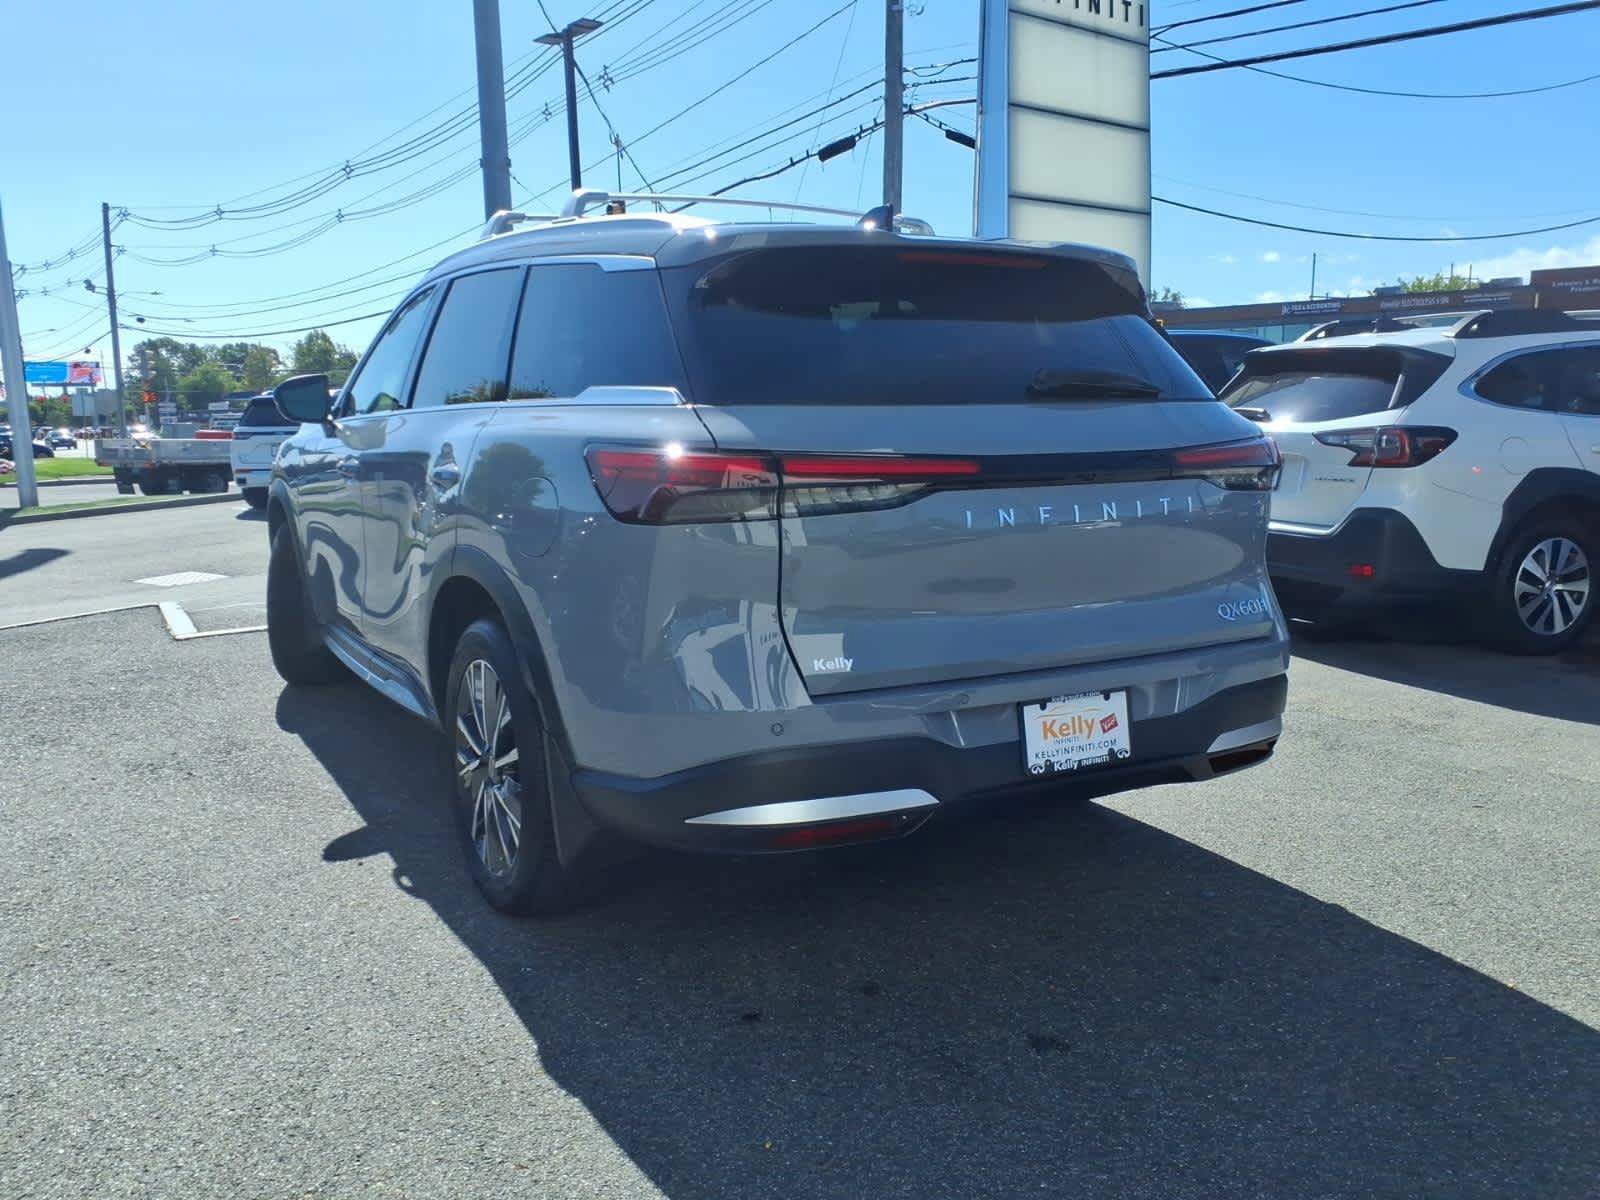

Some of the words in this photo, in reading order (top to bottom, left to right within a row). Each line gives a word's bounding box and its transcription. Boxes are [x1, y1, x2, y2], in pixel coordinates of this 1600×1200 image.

[1042, 0, 1145, 26] NITI
[966, 496, 1193, 528] INFINITI
[813, 656, 854, 672] Kelly
[1042, 714, 1096, 740] Kelly
[1034, 738, 1118, 760] KELLYINFINITI.COM
[1053, 759, 1079, 772] Kelly
[1081, 755, 1110, 767] INFINITI
